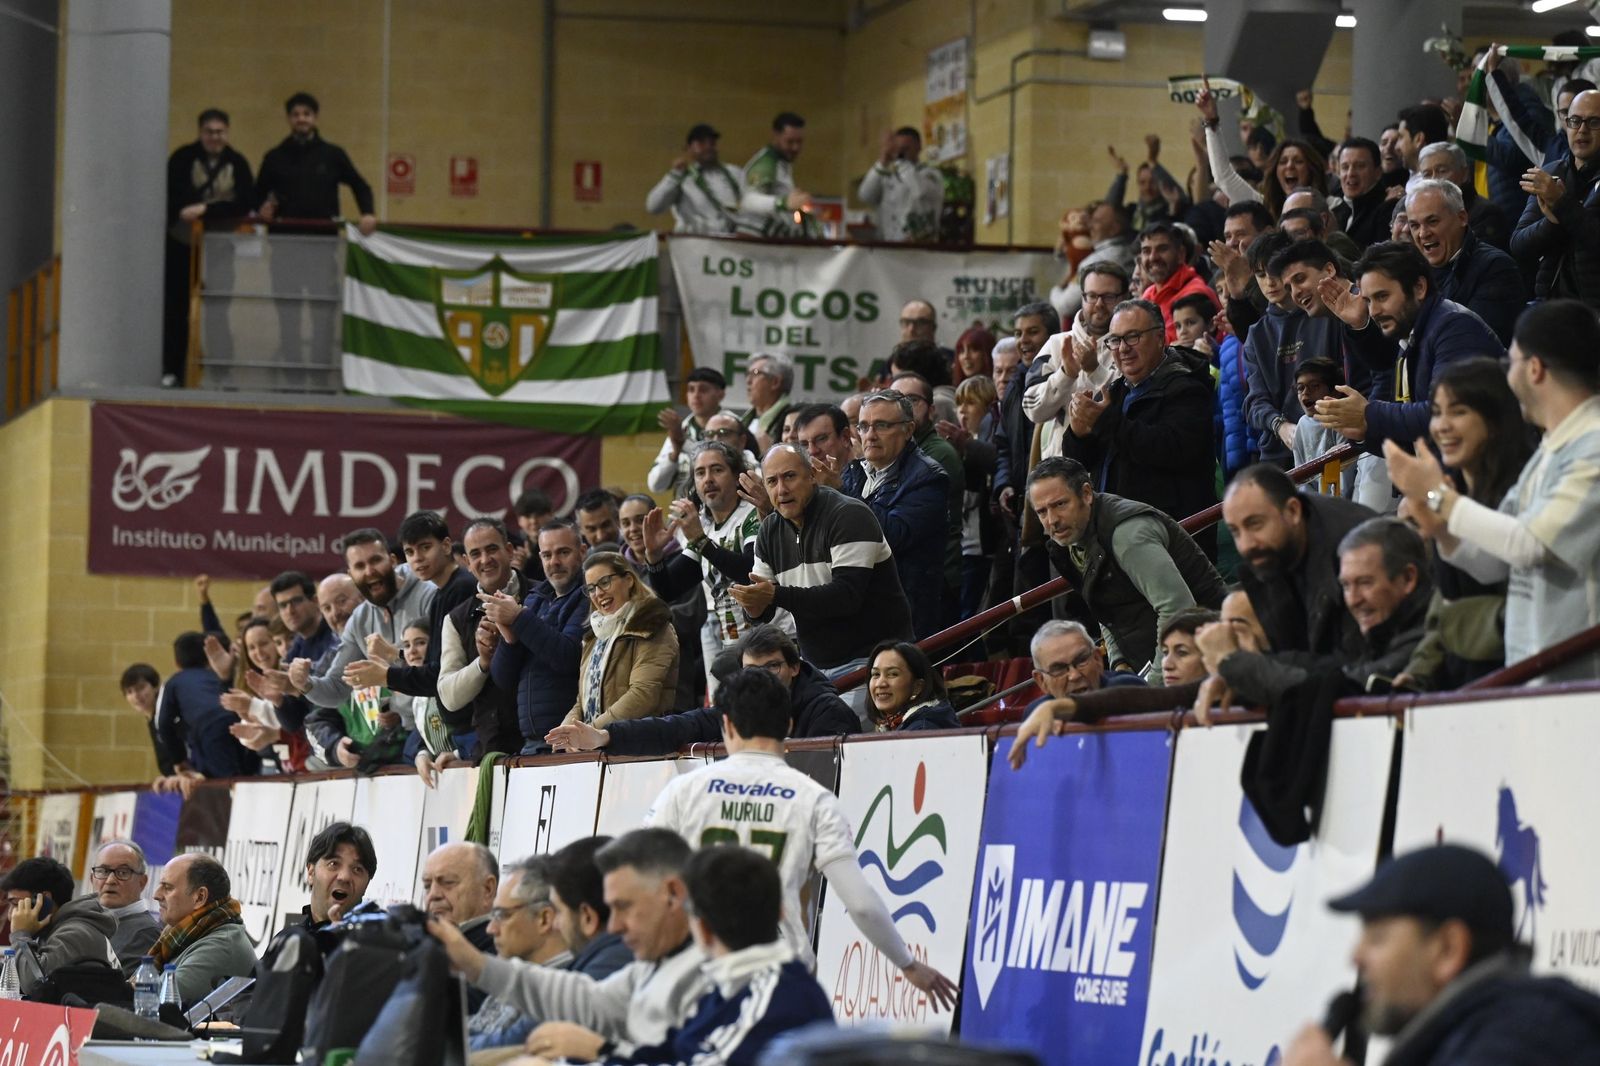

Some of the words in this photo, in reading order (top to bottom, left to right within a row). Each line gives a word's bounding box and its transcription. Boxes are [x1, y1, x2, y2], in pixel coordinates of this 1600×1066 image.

[703, 256, 754, 278] LOS
[731, 286, 879, 322] LOCOS
[765, 326, 821, 347] DEL
[223, 447, 580, 520] IMDECO
[112, 526, 206, 550] Instituto
[213, 530, 325, 558] Municipal
[708, 779, 796, 799] Revalco
[721, 800, 774, 822] MURILO
[1006, 878, 1149, 977] IMANE
[1074, 977, 1100, 1003] COME
[1100, 980, 1128, 1006] SURE
